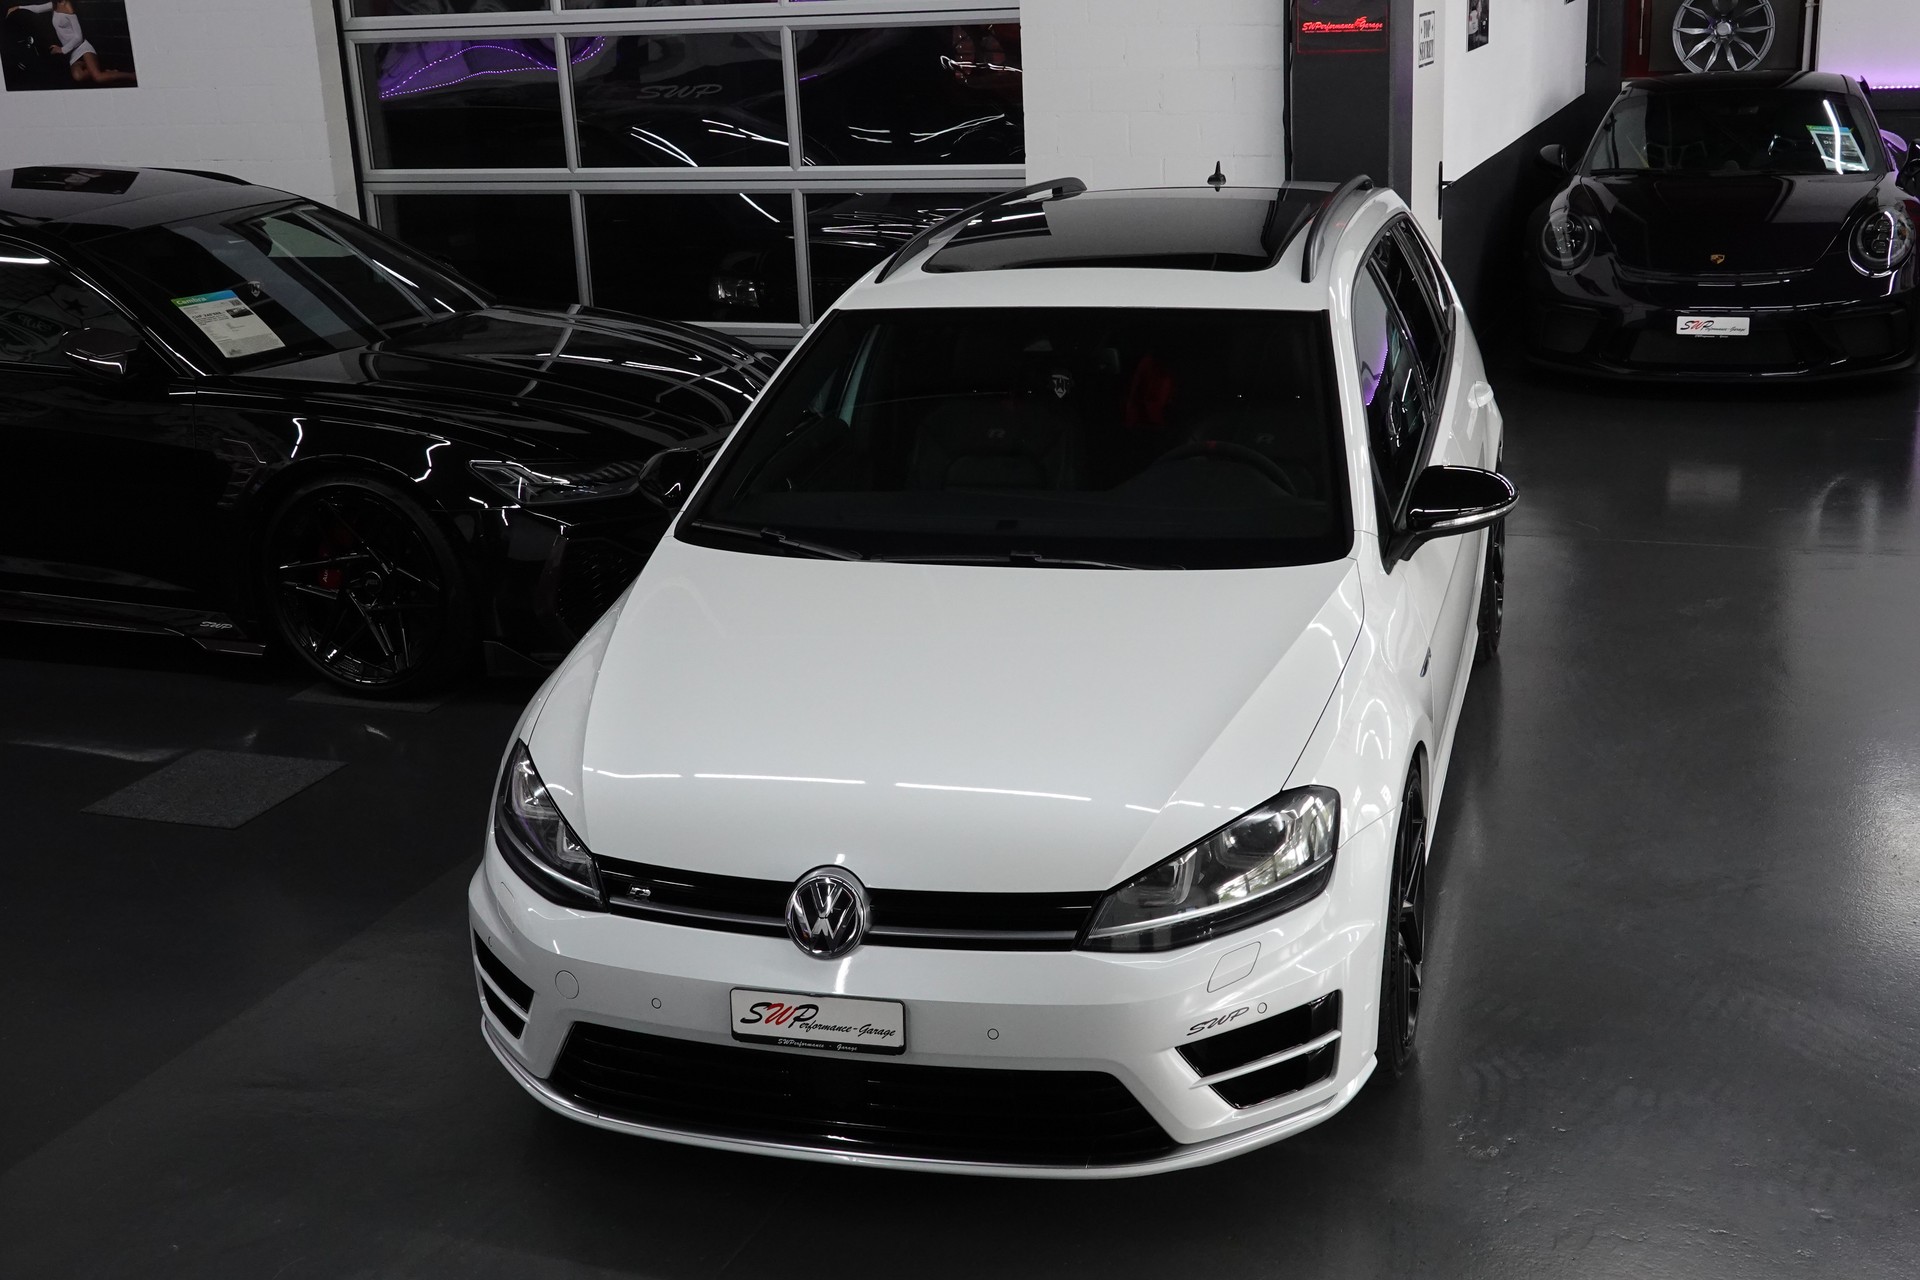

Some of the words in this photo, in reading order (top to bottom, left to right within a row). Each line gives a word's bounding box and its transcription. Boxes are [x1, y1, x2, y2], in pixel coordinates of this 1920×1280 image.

[636, 84, 723, 99] SWP
[200, 621, 233, 629] SWP
[1186, 1006, 1249, 1036] SWP
[836, 1043, 858, 1052] Garage
